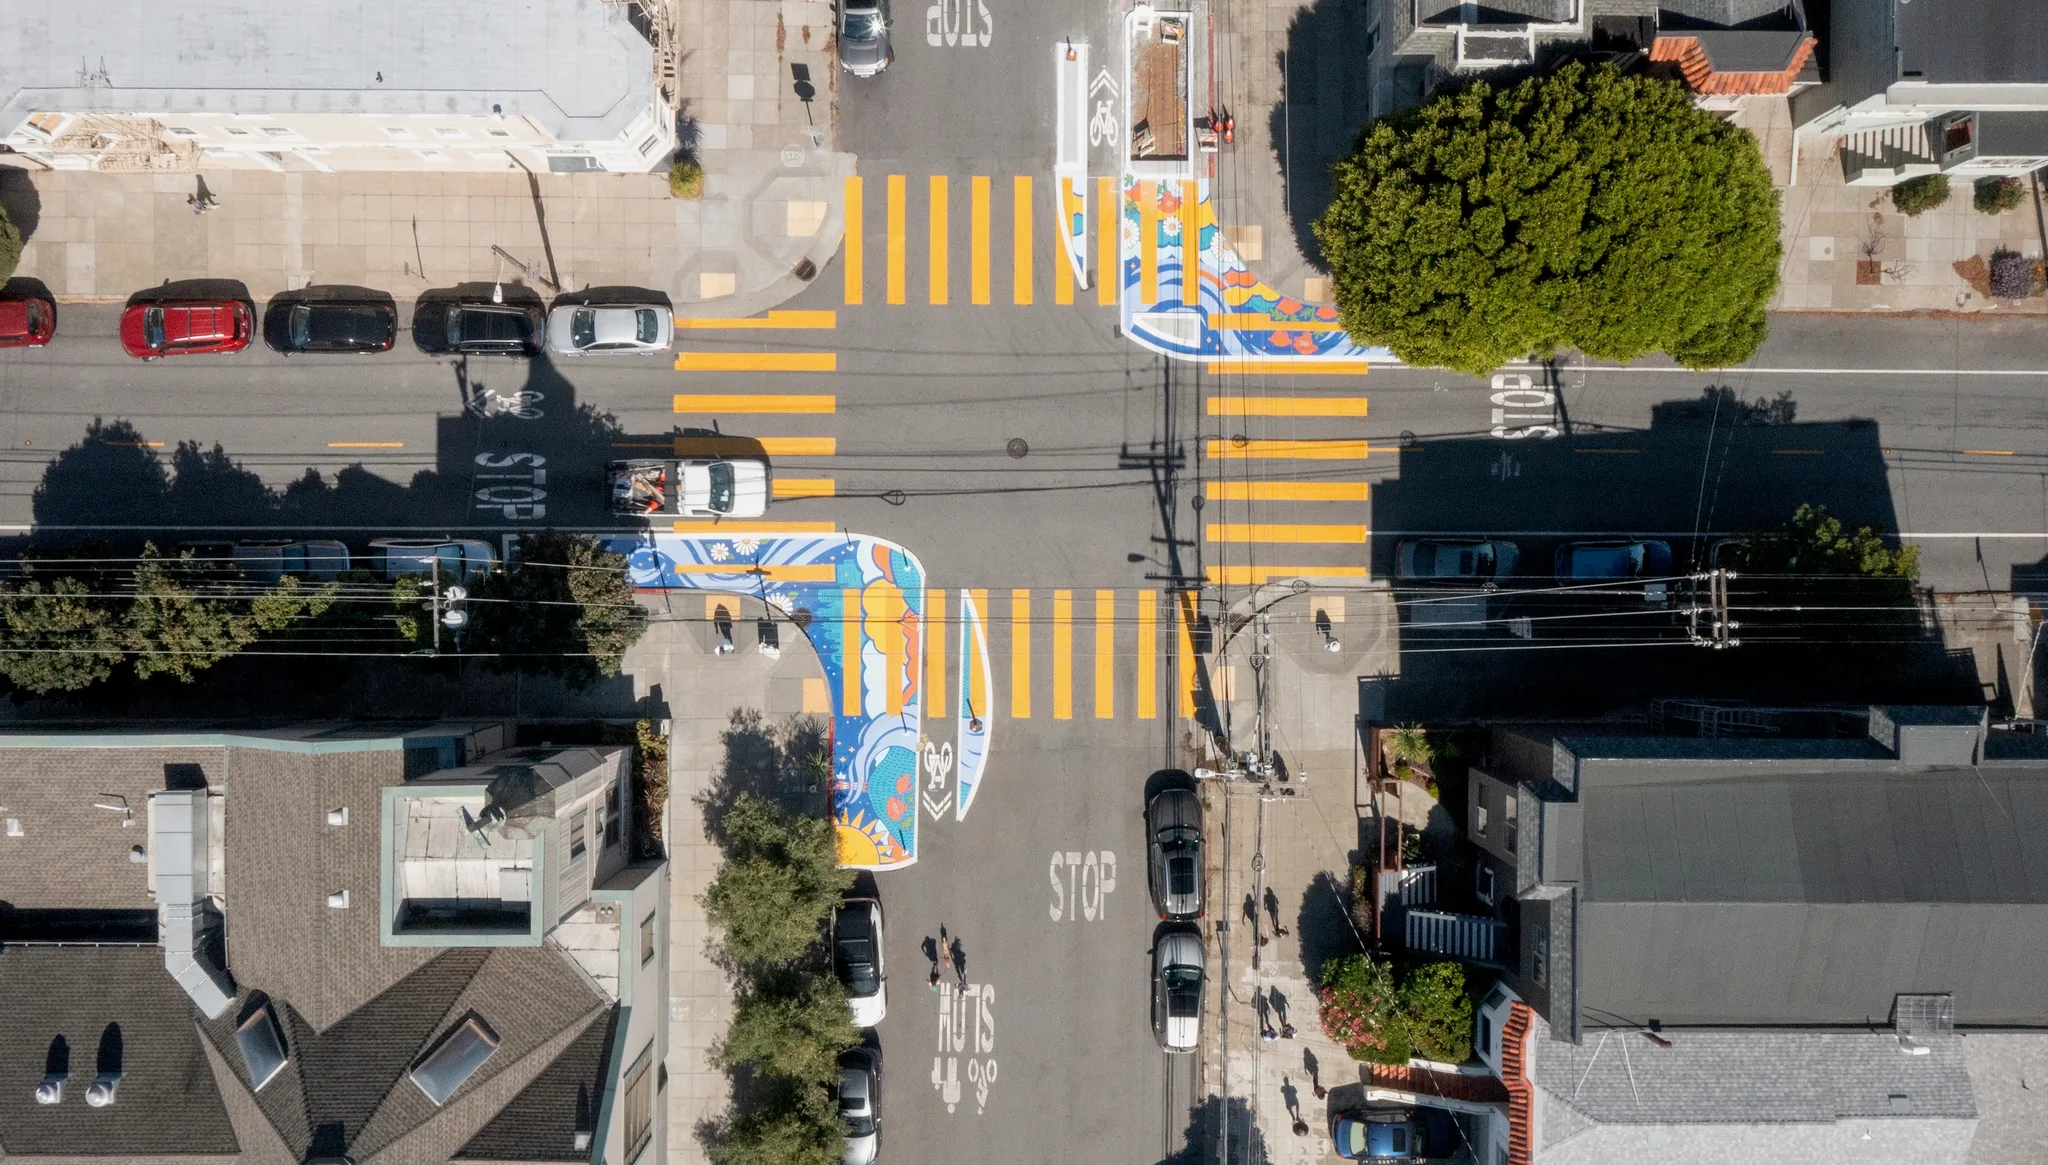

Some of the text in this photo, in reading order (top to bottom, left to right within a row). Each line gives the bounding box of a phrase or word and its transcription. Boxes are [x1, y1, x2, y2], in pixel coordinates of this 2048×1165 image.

[926, 0, 993, 47] STOP
[1490, 374, 1559, 439] STOP
[475, 453, 547, 520] STOP
[1050, 851, 1117, 922] STOP
[938, 982, 995, 1053] SLOW
